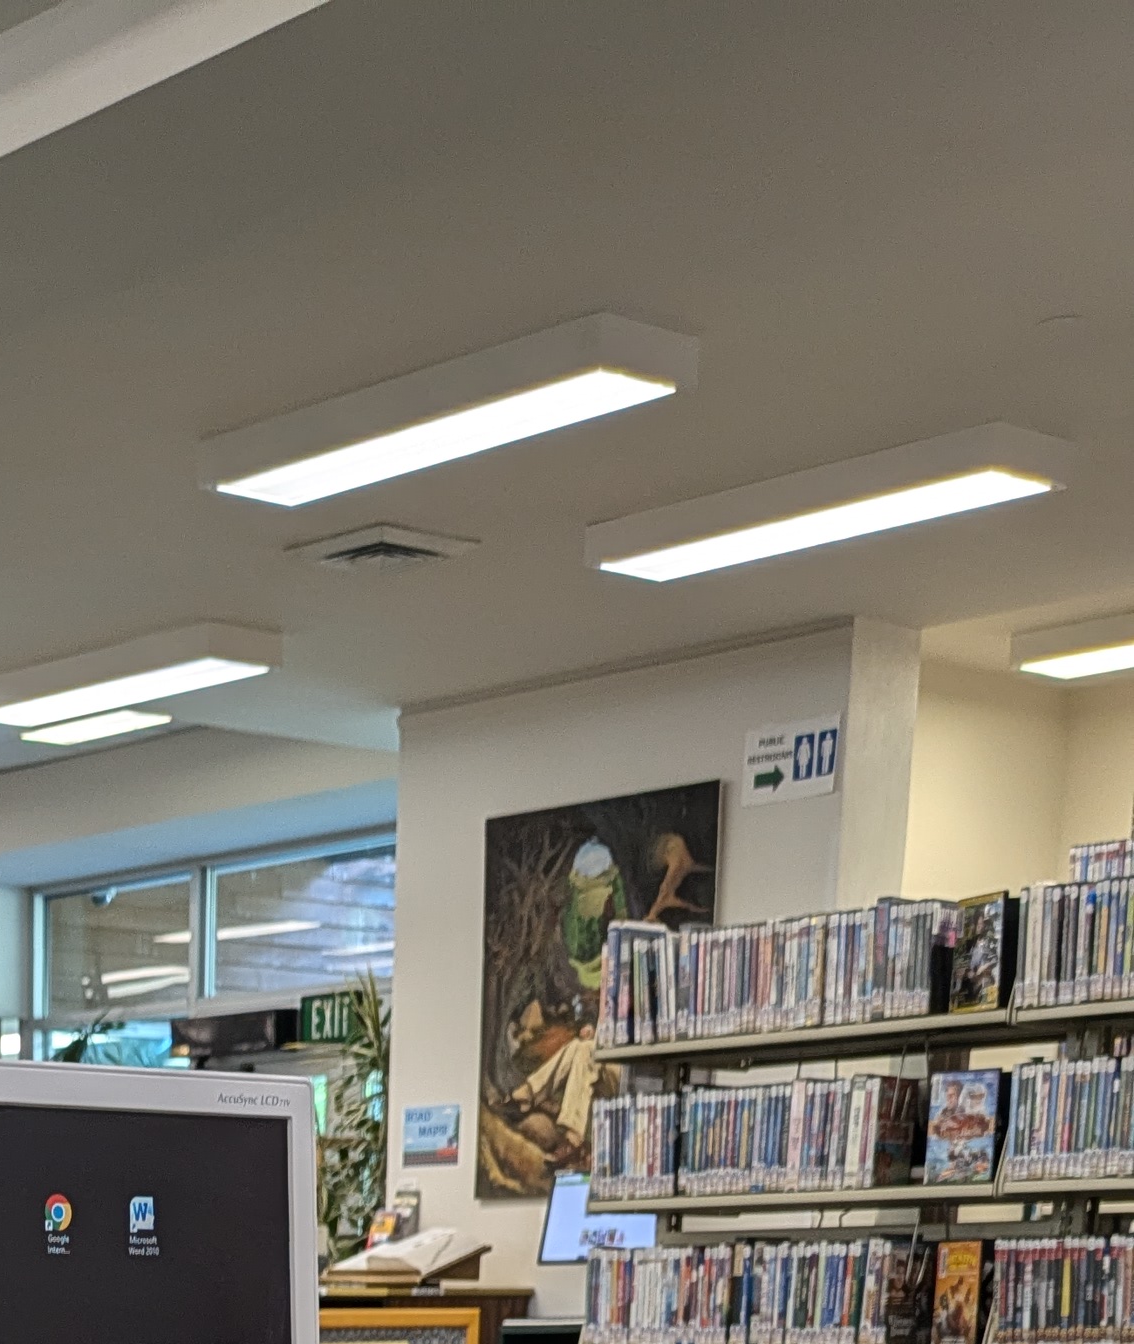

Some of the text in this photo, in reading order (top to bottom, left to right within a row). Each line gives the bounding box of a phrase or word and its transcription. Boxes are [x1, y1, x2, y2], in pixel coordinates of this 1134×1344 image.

[311, 995, 351, 1040] EXIT
[217, 1092, 258, 1107] AccuSync
[48, 1233, 69, 1245] Google
[129, 1235, 157, 1245] Microsoft
[128, 1246, 145, 1256] Word
